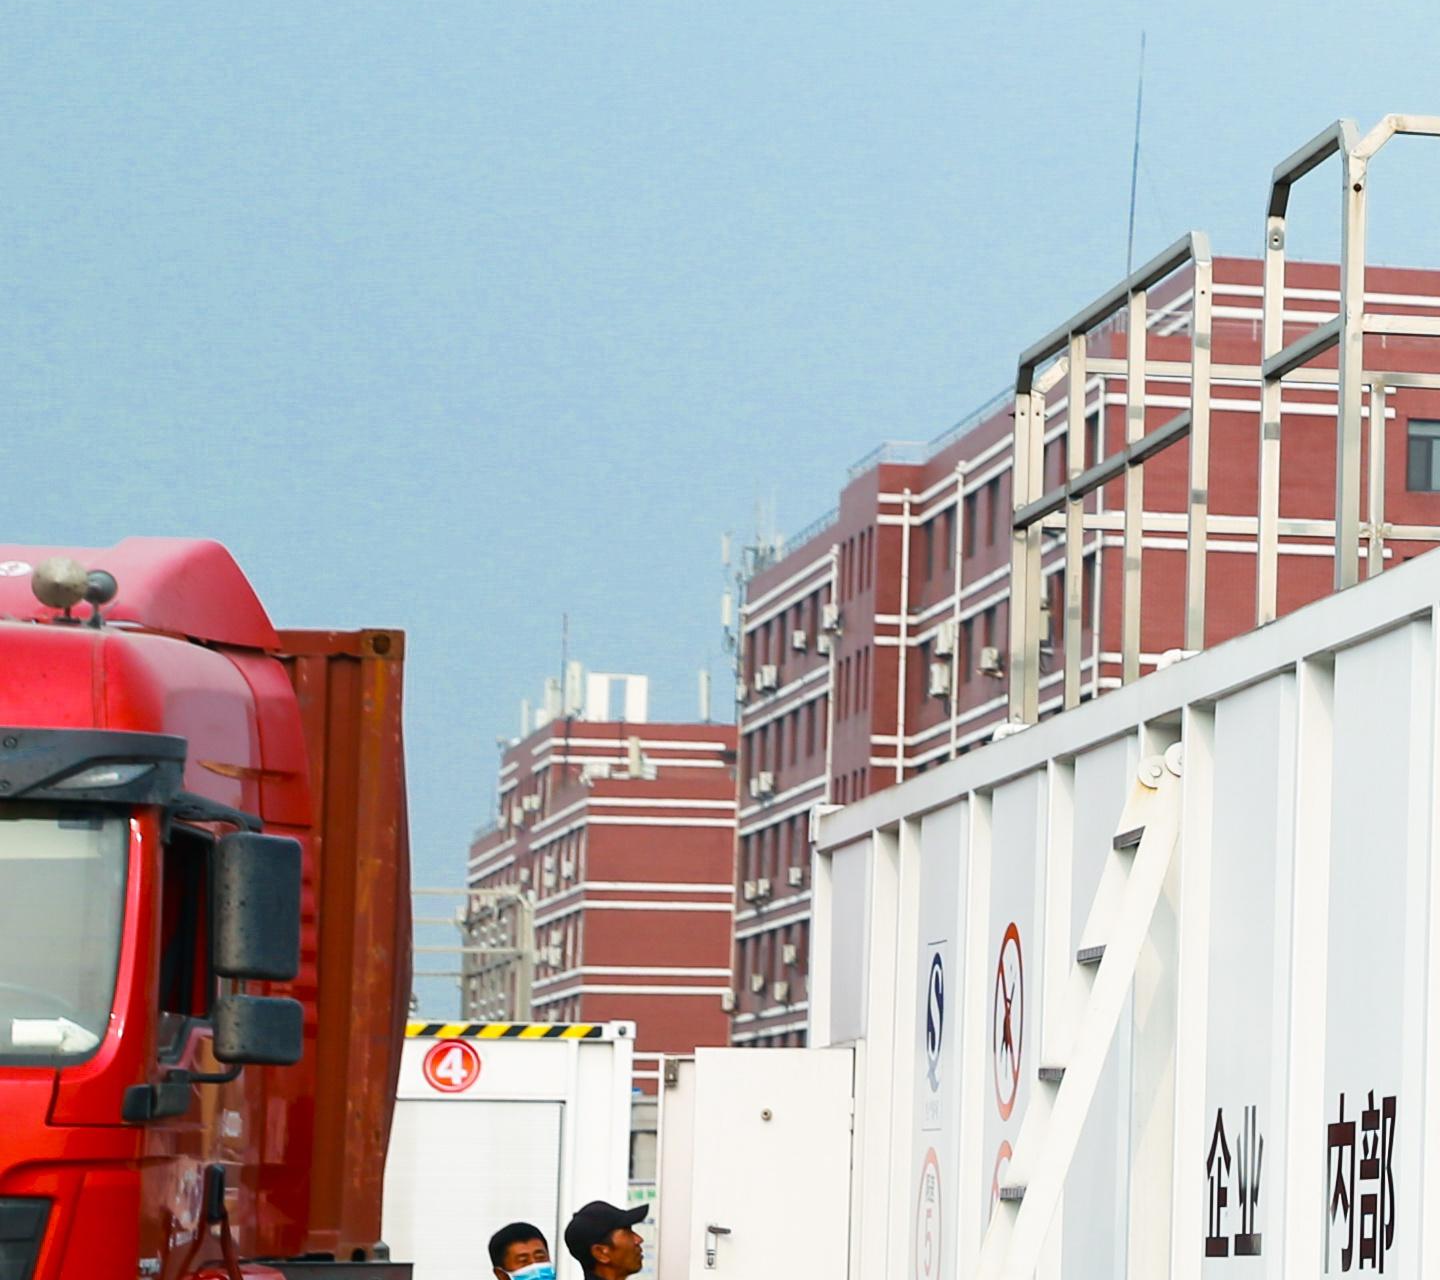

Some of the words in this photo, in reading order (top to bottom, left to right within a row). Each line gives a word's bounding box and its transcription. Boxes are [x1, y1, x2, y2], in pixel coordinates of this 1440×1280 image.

[436, 1048, 468, 1085] 4
[1205, 1105, 1264, 1257] 企业
[1324, 1089, 1397, 1274] 内部
